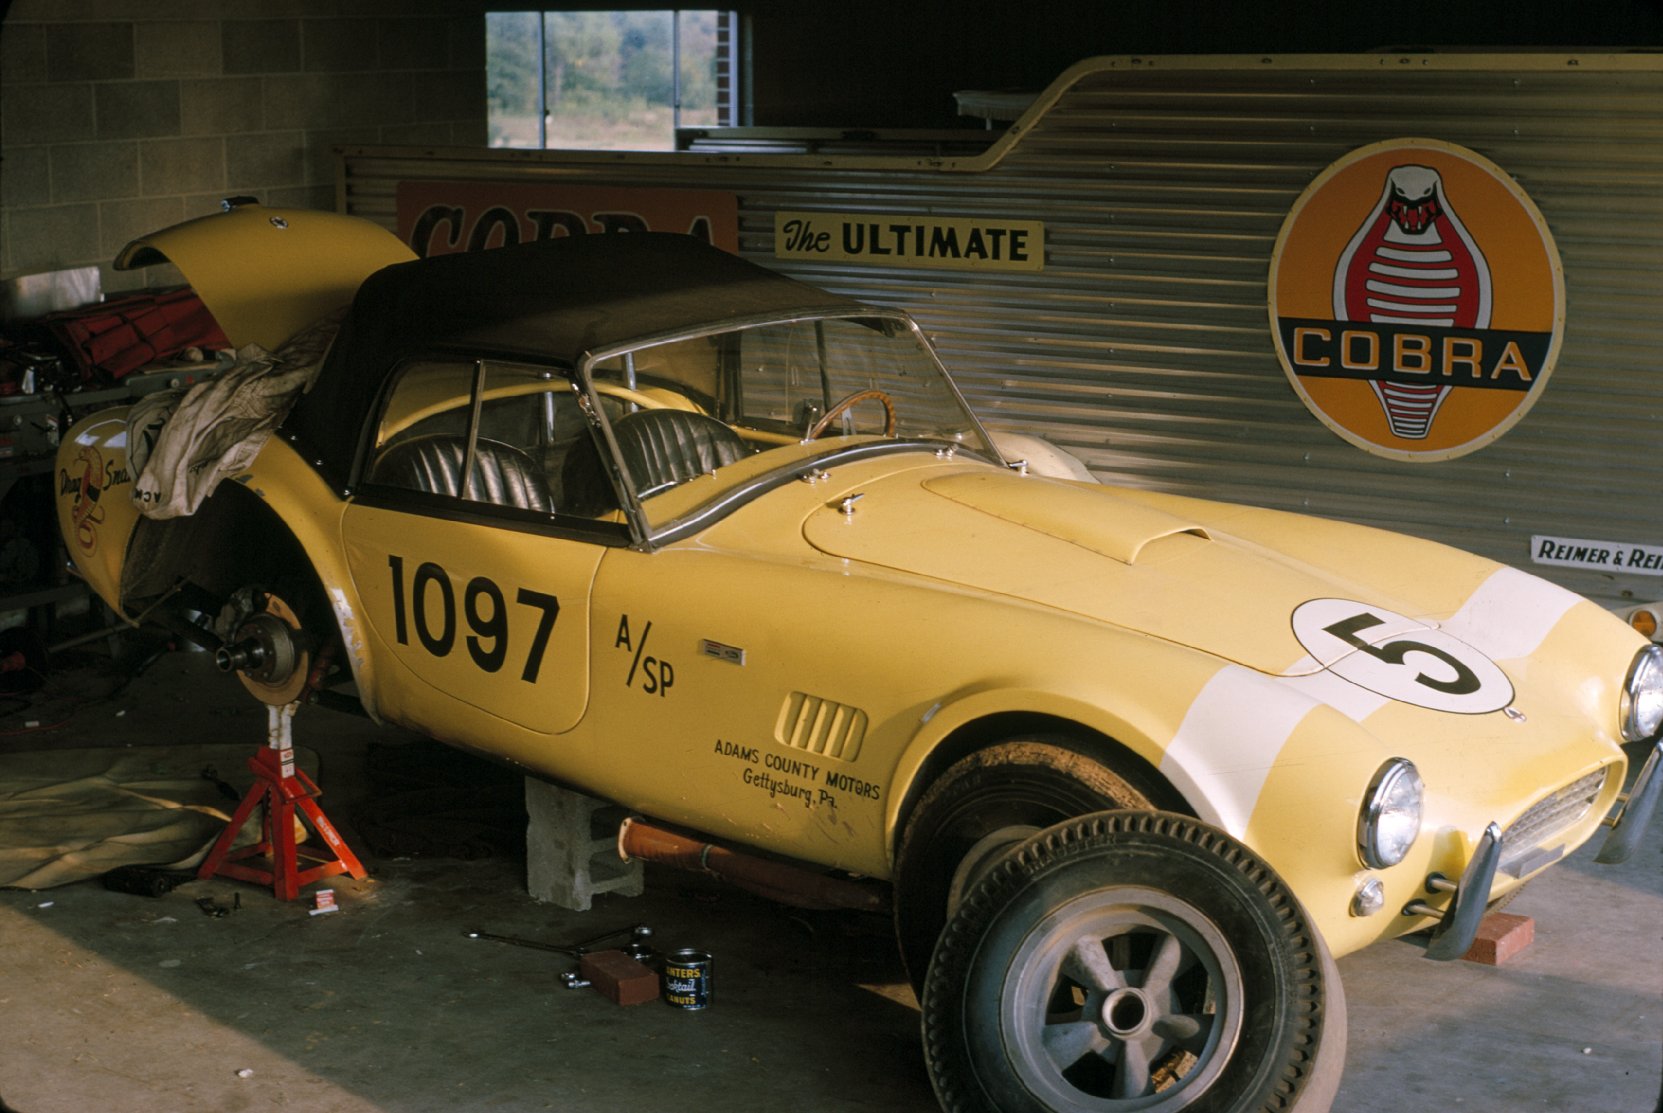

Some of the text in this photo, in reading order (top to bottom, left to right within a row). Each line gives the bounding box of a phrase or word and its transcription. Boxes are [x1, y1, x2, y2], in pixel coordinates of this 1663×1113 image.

[783, 219, 1029, 262] The ULTIMATE
[1293, 326, 1533, 383] COBRA
[1538, 540, 1663, 571] REIMER & REI
[388, 555, 561, 684] 1097
[1322, 612, 1481, 696] 5
[714, 739, 881, 801] ADAMS COUNTY MOTORS
[743, 767, 839, 810] Gettysburg, Pa.
